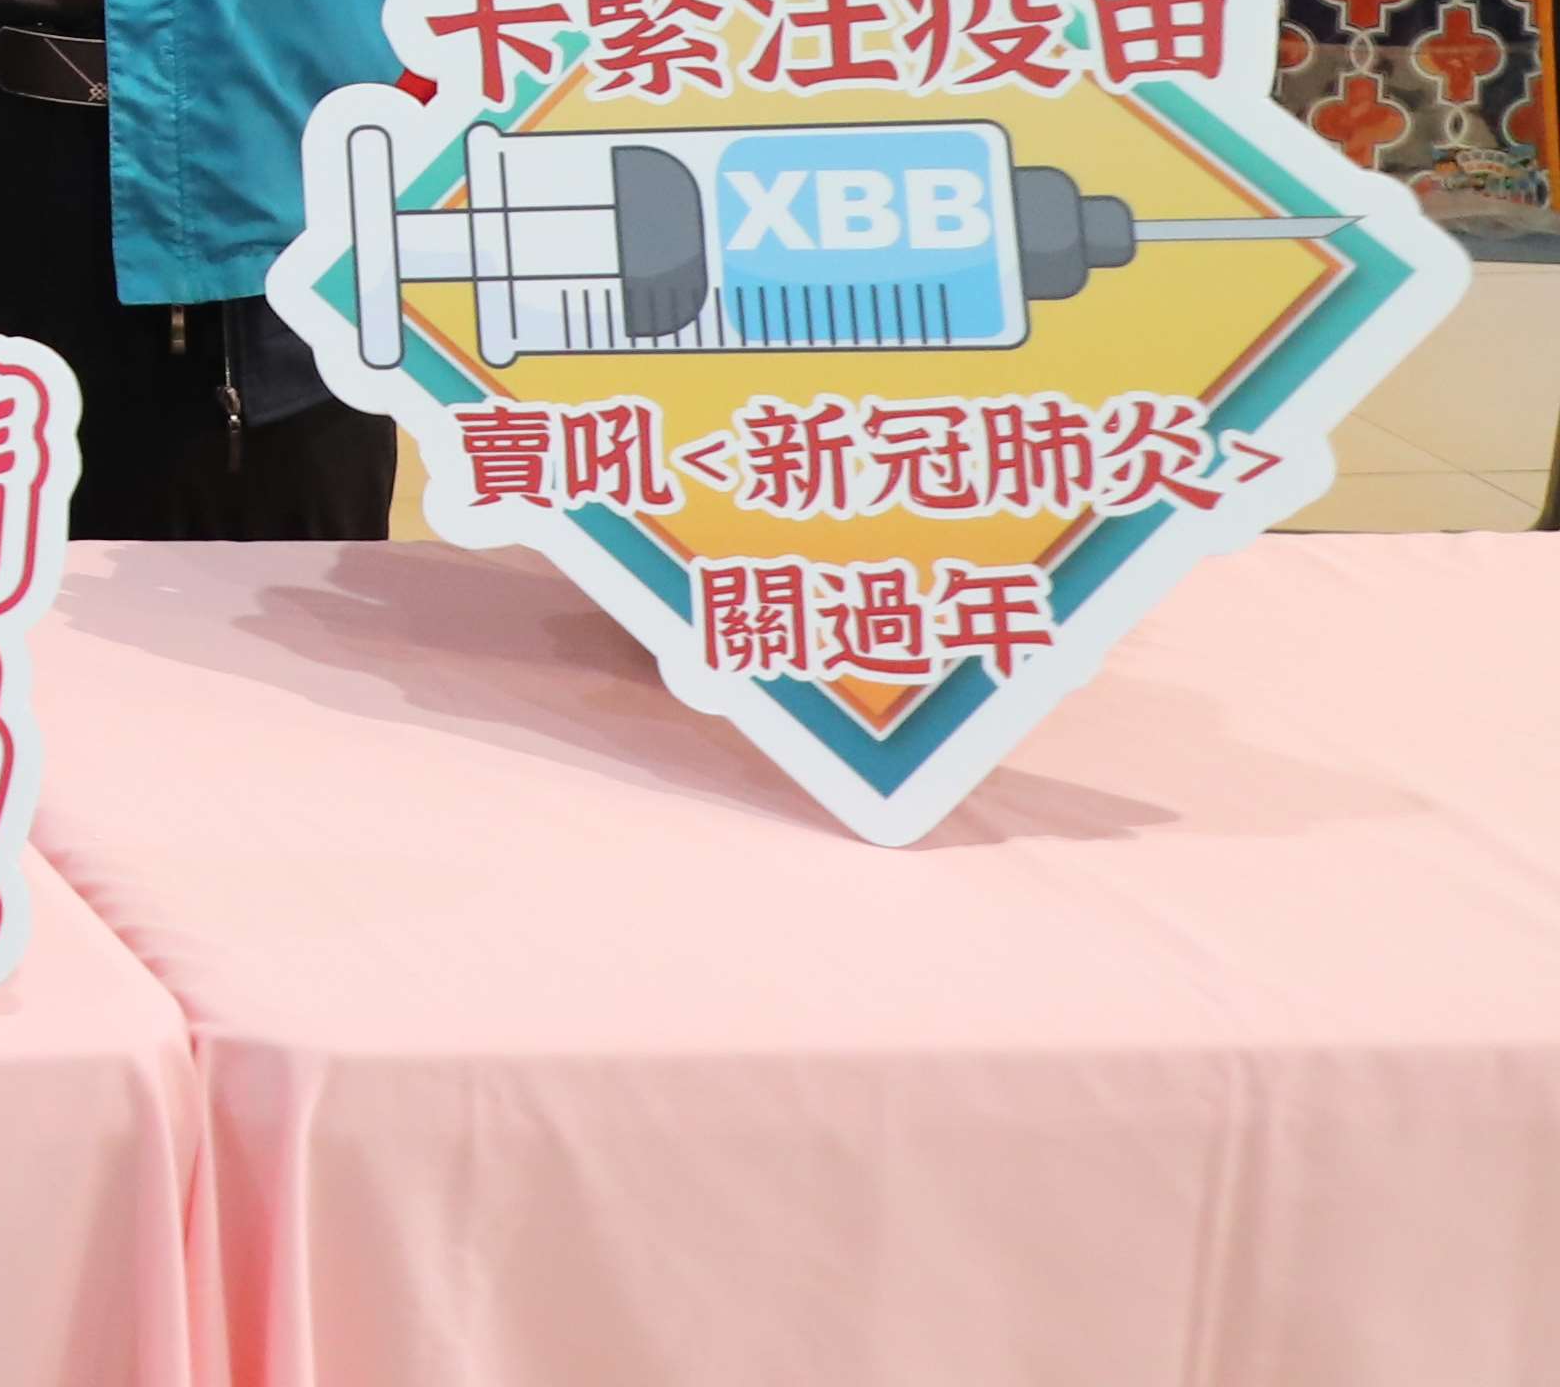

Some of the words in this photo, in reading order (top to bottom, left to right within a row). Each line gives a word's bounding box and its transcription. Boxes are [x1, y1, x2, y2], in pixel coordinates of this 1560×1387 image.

[722, 167, 991, 252] XBB
[702, 564, 1055, 679] 關過年
